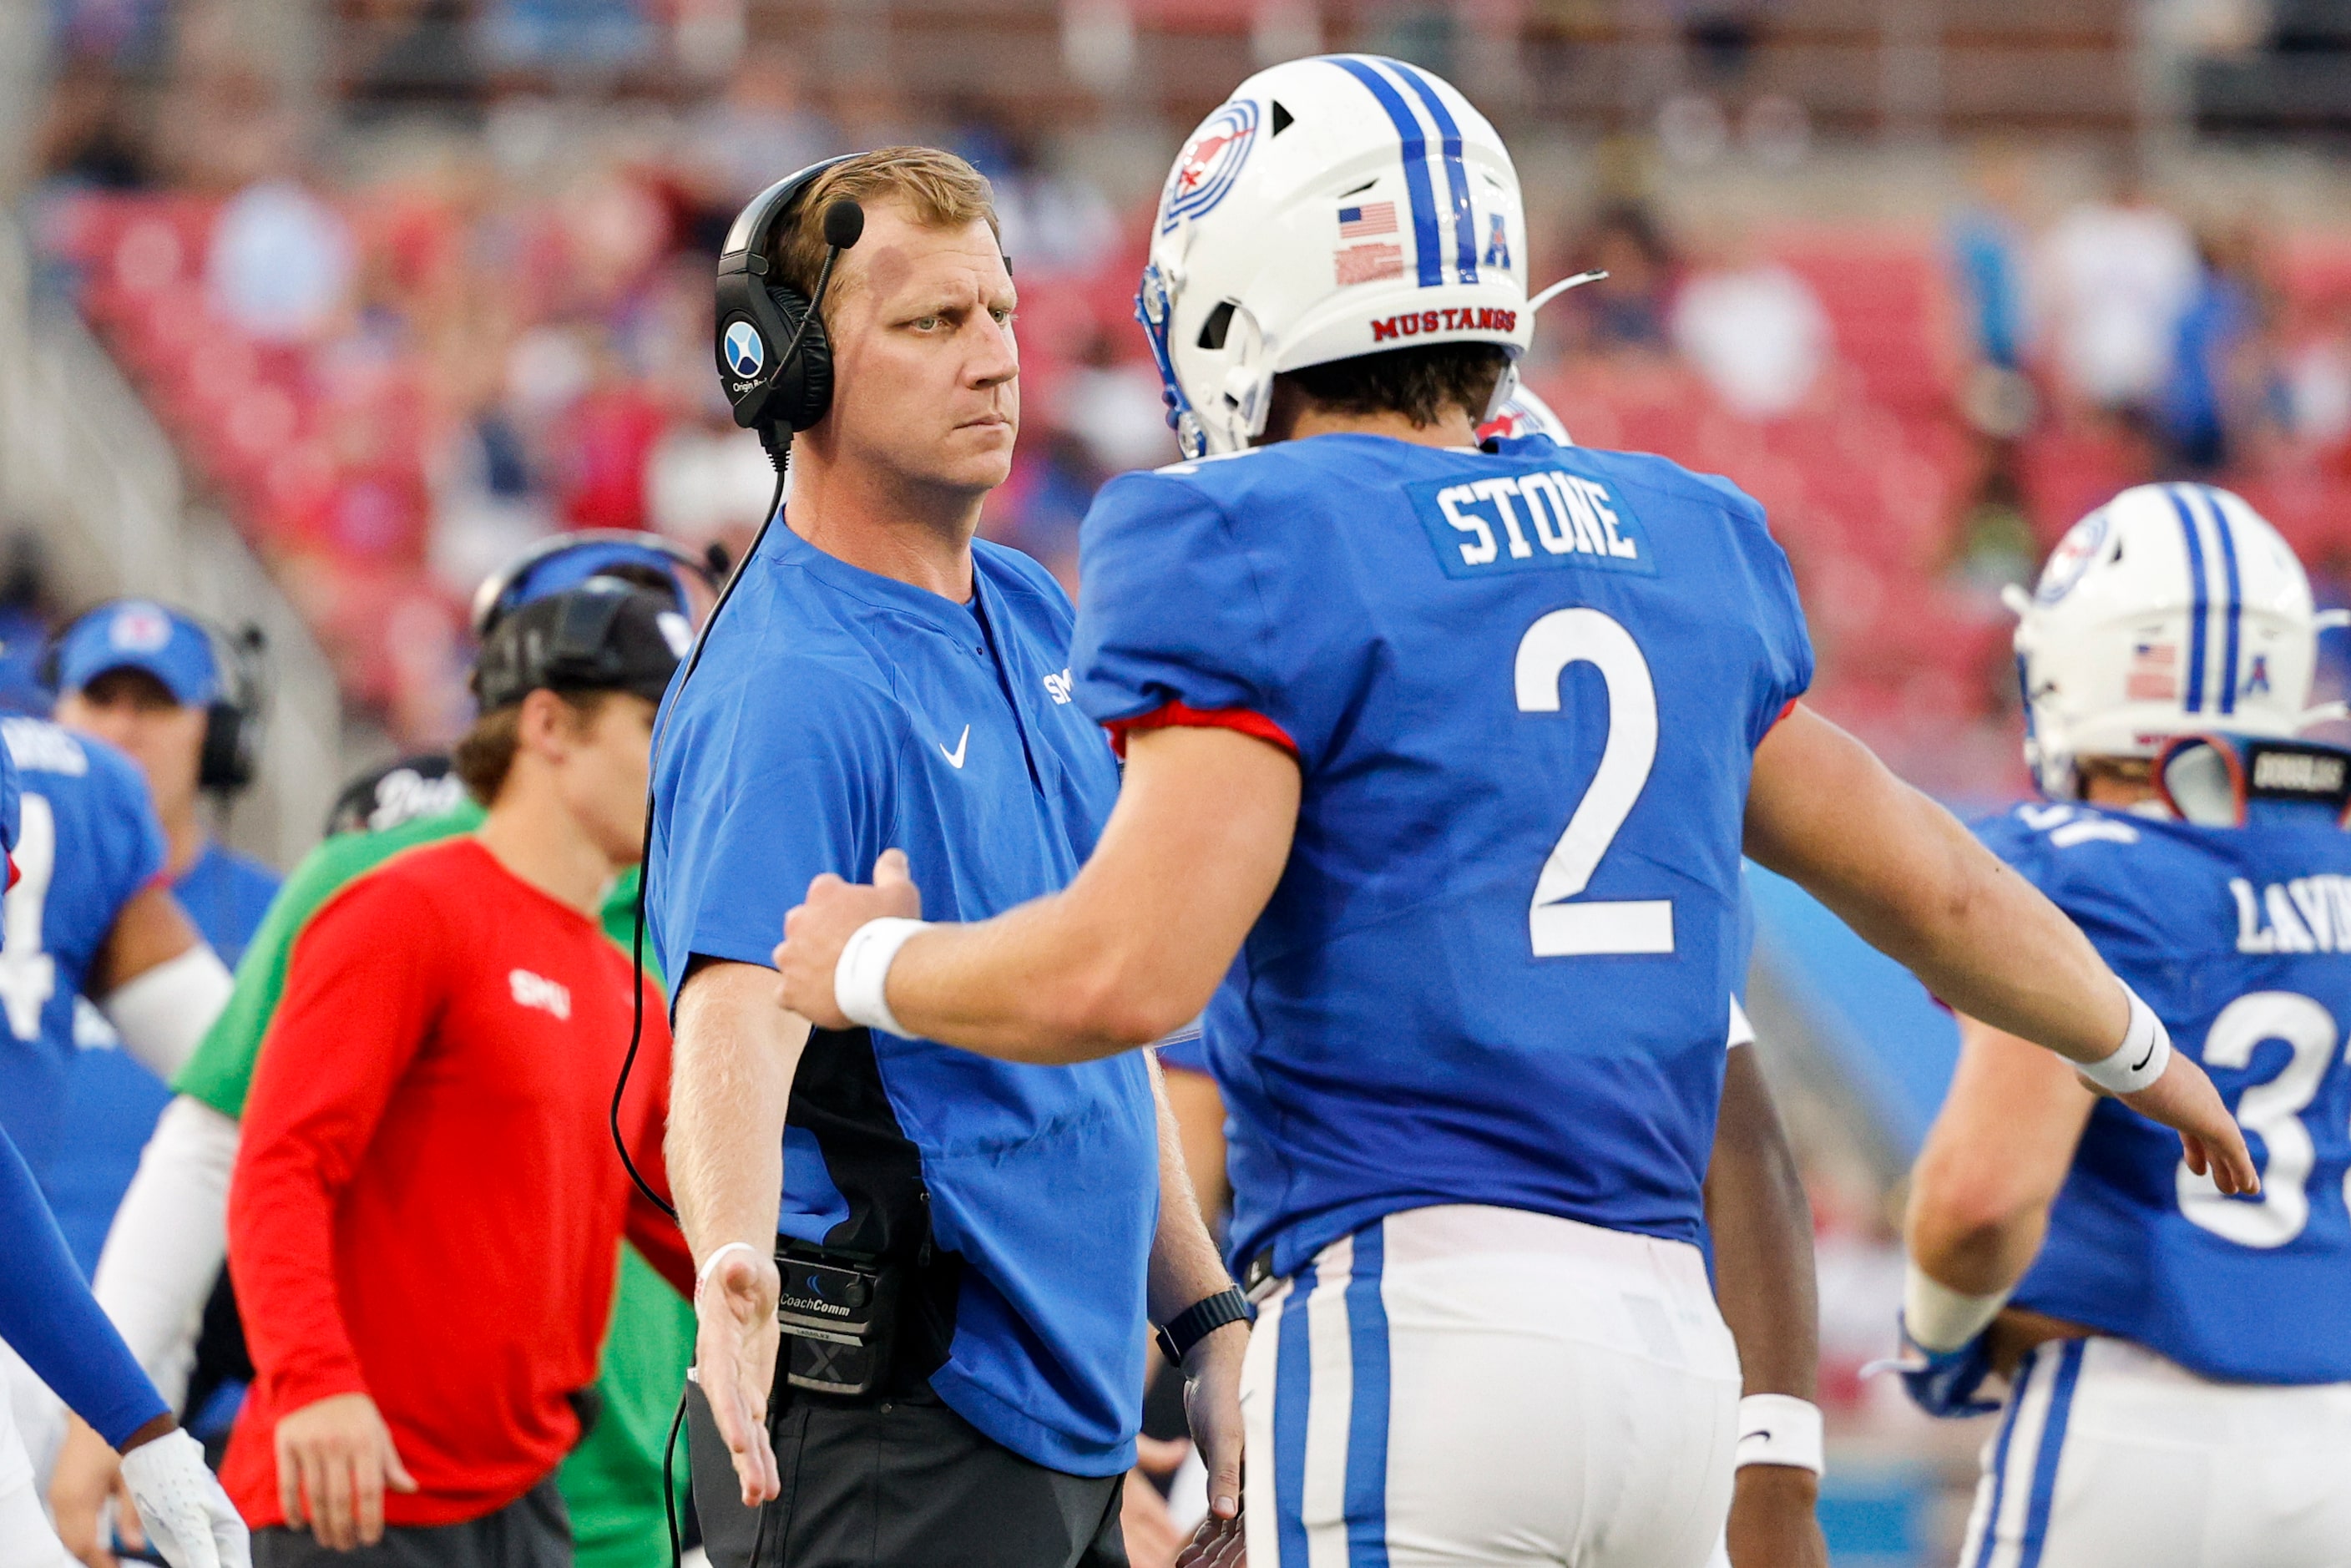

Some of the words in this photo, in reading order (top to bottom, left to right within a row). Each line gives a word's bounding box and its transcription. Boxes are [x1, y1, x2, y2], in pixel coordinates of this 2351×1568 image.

[1371, 306, 1517, 342] MUSTANGS
[732, 380, 754, 392] Origin
[1437, 471, 1638, 565] STONE
[1044, 666, 1073, 706] SM
[1514, 606, 1675, 957] 2
[780, 1293, 851, 1317] CoachComm
